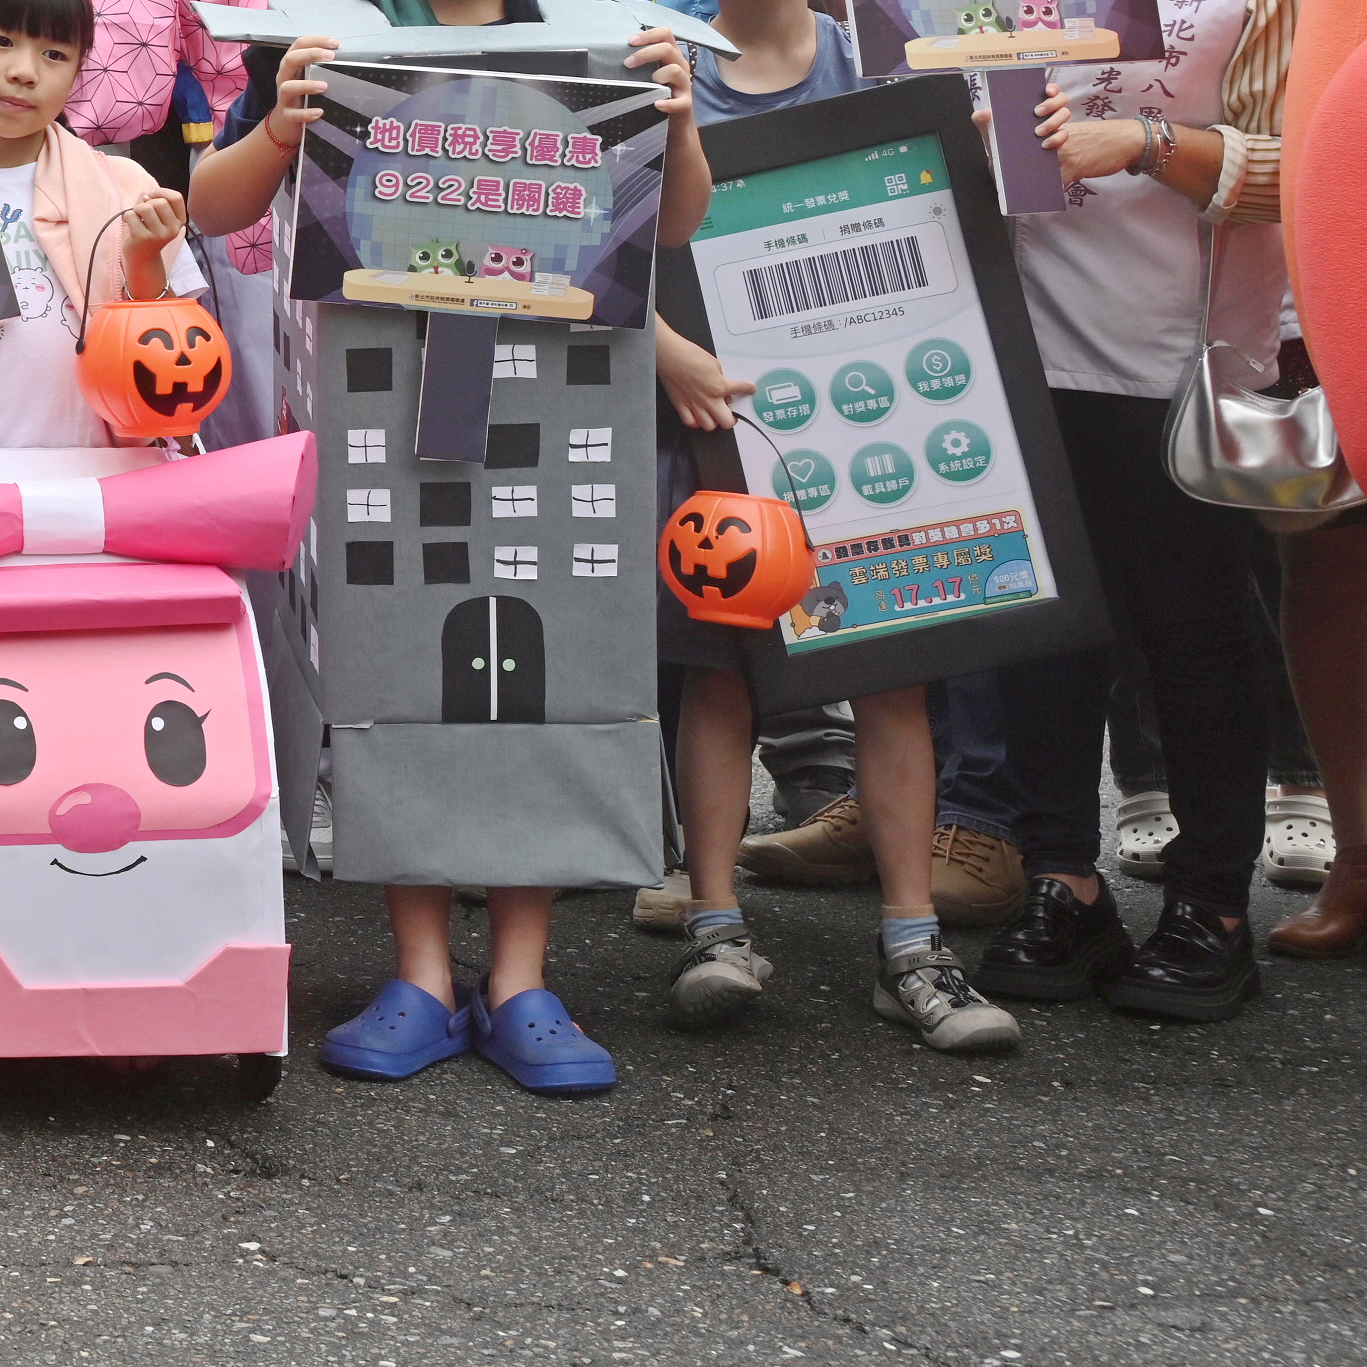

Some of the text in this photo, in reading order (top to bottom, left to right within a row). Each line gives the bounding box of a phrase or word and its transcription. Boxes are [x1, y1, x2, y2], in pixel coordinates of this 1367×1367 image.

[367, 115, 603, 169] 地價稅享優惠
[881, 148, 895, 157] 4G
[374, 169, 587, 220] 922是關鍵
[781, 190, 850, 214] 統一發票兌獎
[763, 217, 886, 252] 手機條碼 捐贈條碼
[917, 374, 967, 392] 我要領獎
[762, 404, 811, 423] 發票存摺
[841, 396, 891, 416] 對獎專區
[938, 456, 988, 474] 系統設定
[862, 478, 910, 497] 載具歸戶
[849, 544, 995, 585] 雲端發票專屬獎
[890, 577, 963, 608] 17.17
